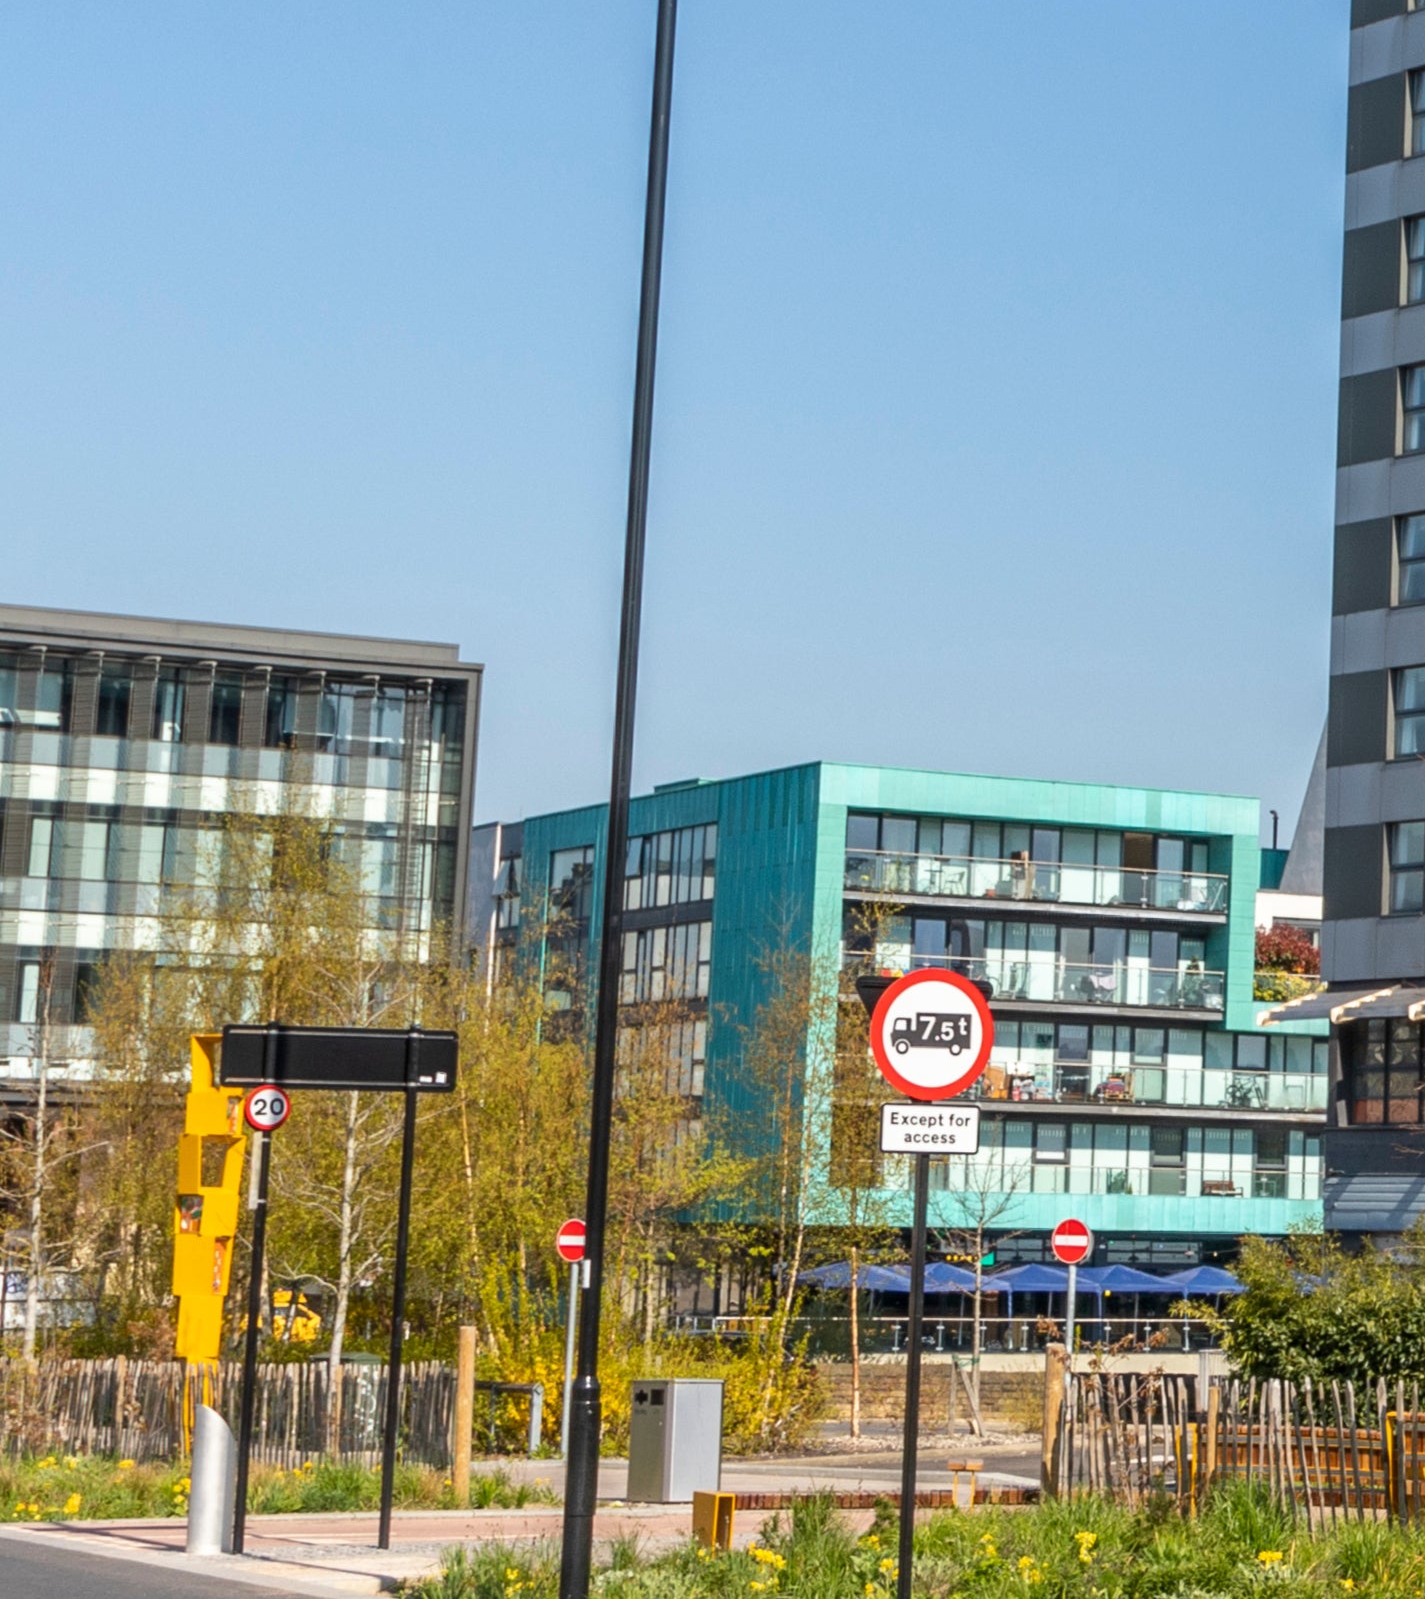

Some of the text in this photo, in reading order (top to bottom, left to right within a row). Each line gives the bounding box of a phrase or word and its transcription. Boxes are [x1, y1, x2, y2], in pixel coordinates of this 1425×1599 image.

[254, 1097, 285, 1116] 20
[890, 1112, 971, 1128] Except for
[904, 1133, 956, 1144] access
